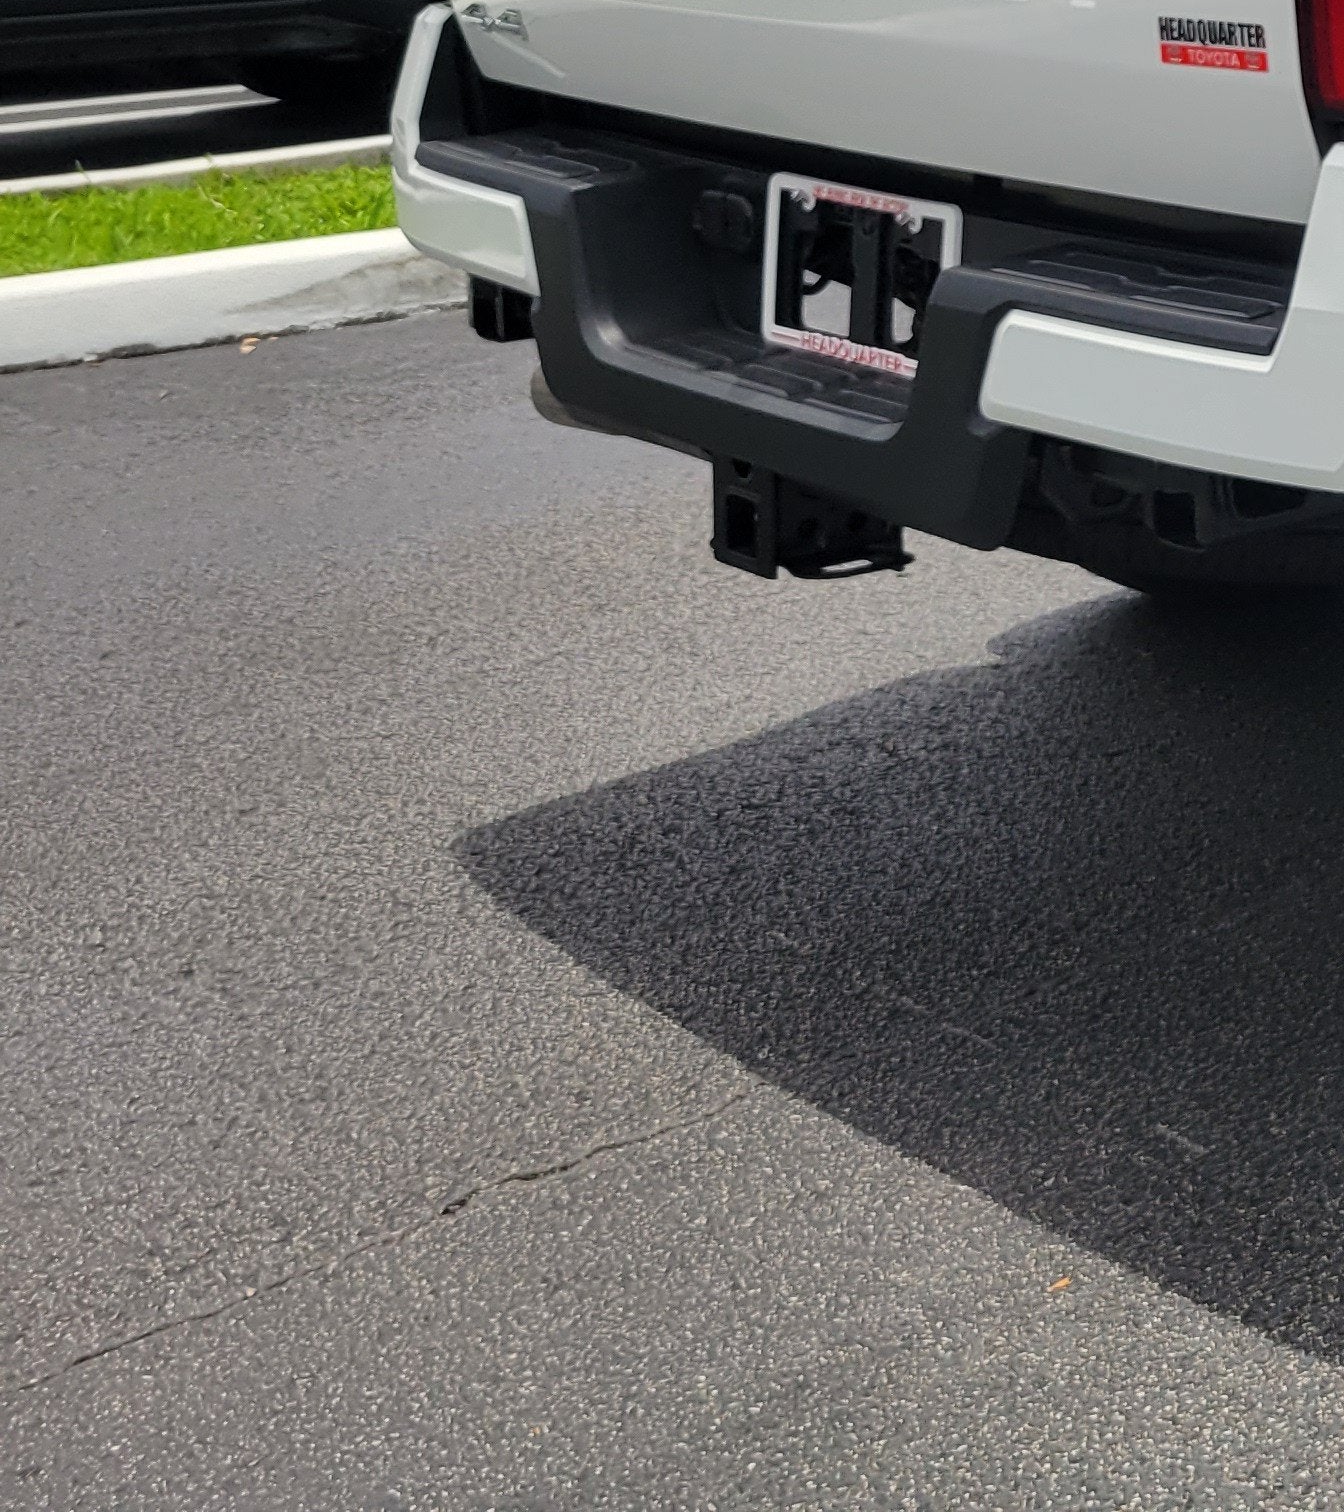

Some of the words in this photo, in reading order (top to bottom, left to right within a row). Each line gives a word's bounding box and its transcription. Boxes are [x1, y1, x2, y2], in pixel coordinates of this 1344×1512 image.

[1158, 15, 1267, 49] HEADQUARTER
[1187, 49, 1242, 66] TOYOTA
[800, 331, 906, 372] HEADQUARTER
